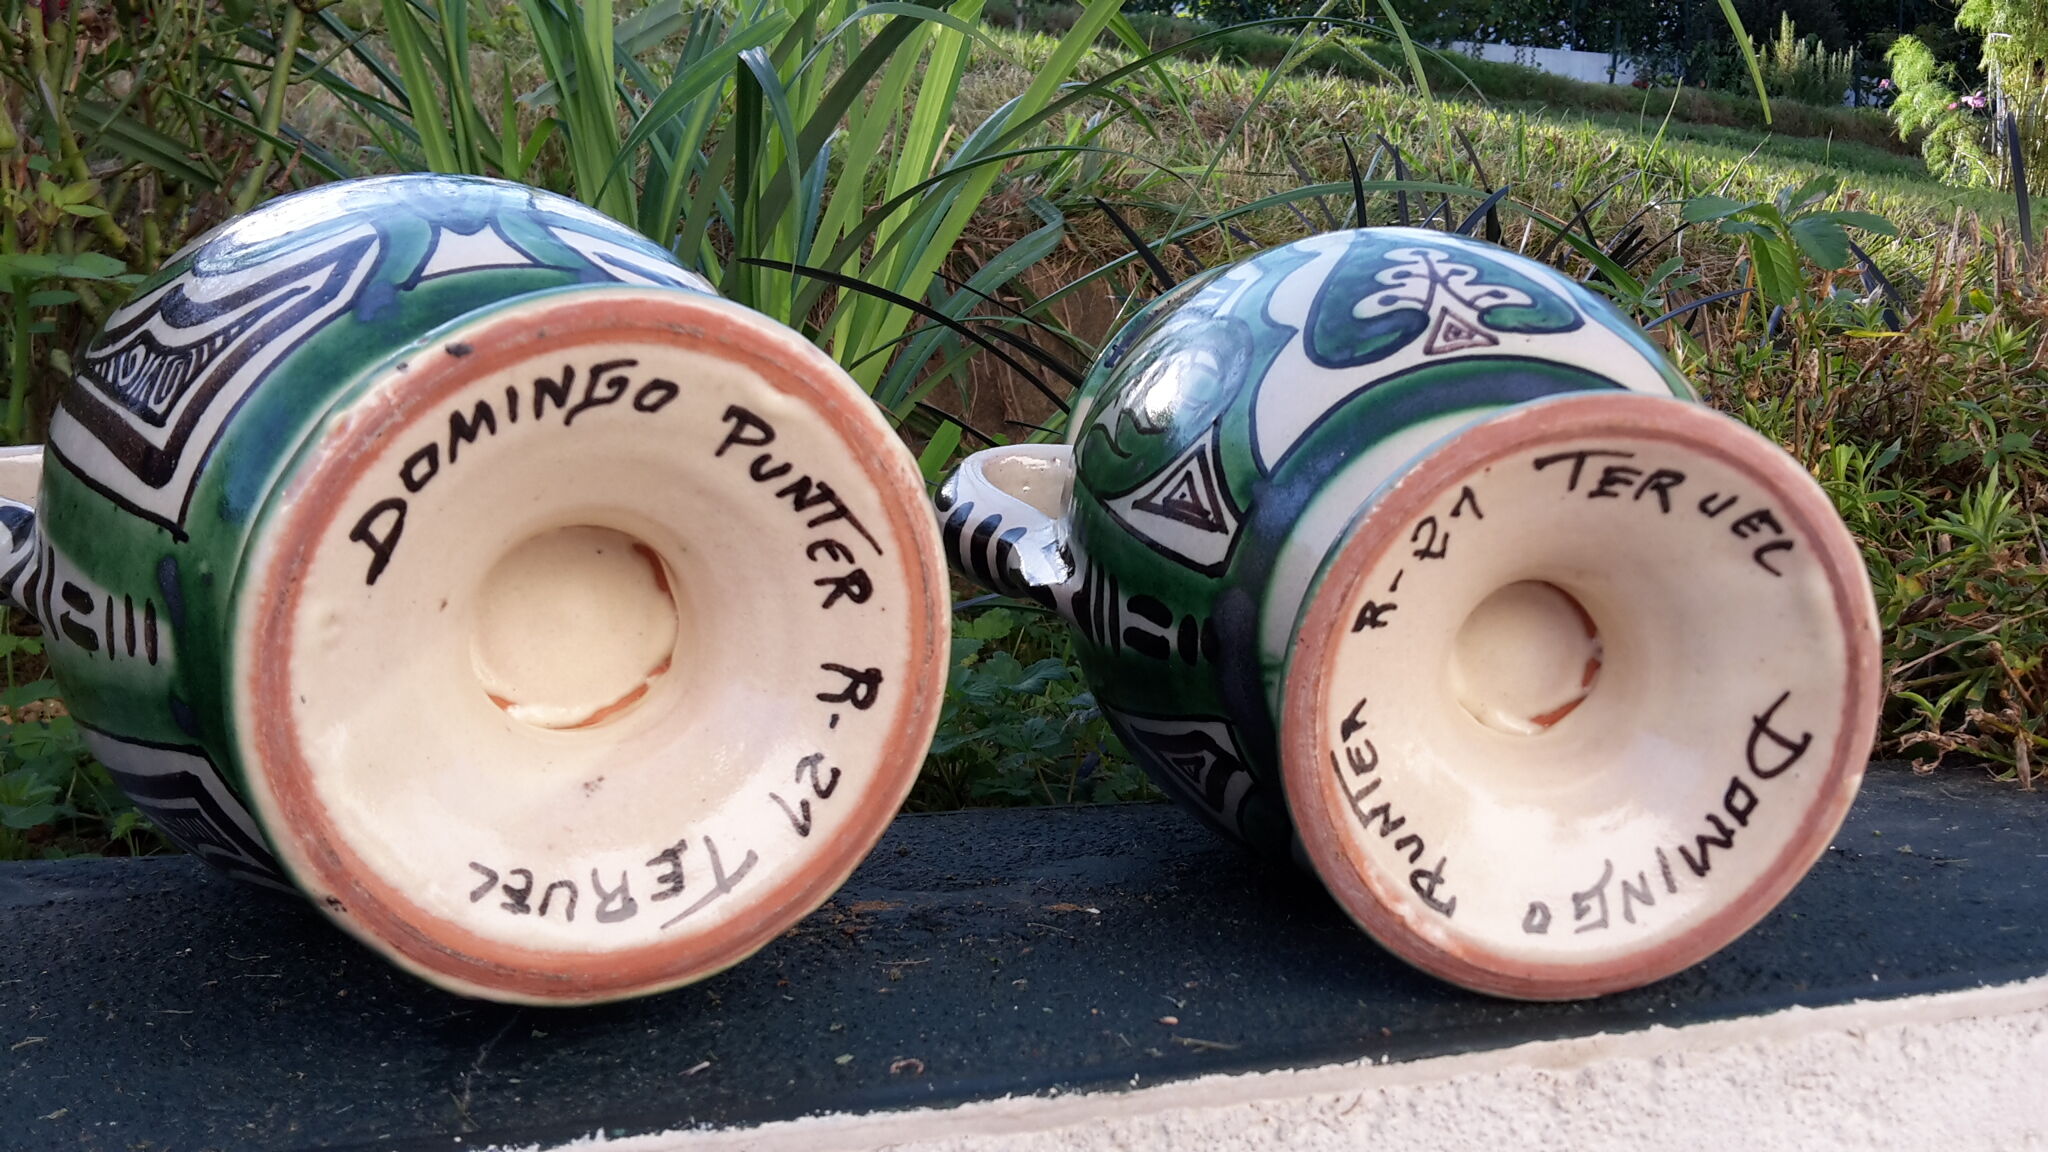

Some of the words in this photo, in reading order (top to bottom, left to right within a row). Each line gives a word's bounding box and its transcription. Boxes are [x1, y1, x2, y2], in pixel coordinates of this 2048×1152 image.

[350, 360, 678, 585] DOMINGO
[715, 405, 883, 609] PUNTER
[1534, 451, 1795, 577] TERUEL
[470, 836, 758, 929] TERUEL
[1331, 698, 1456, 917] PUNTER
[1523, 692, 1813, 934] DOMINGO
